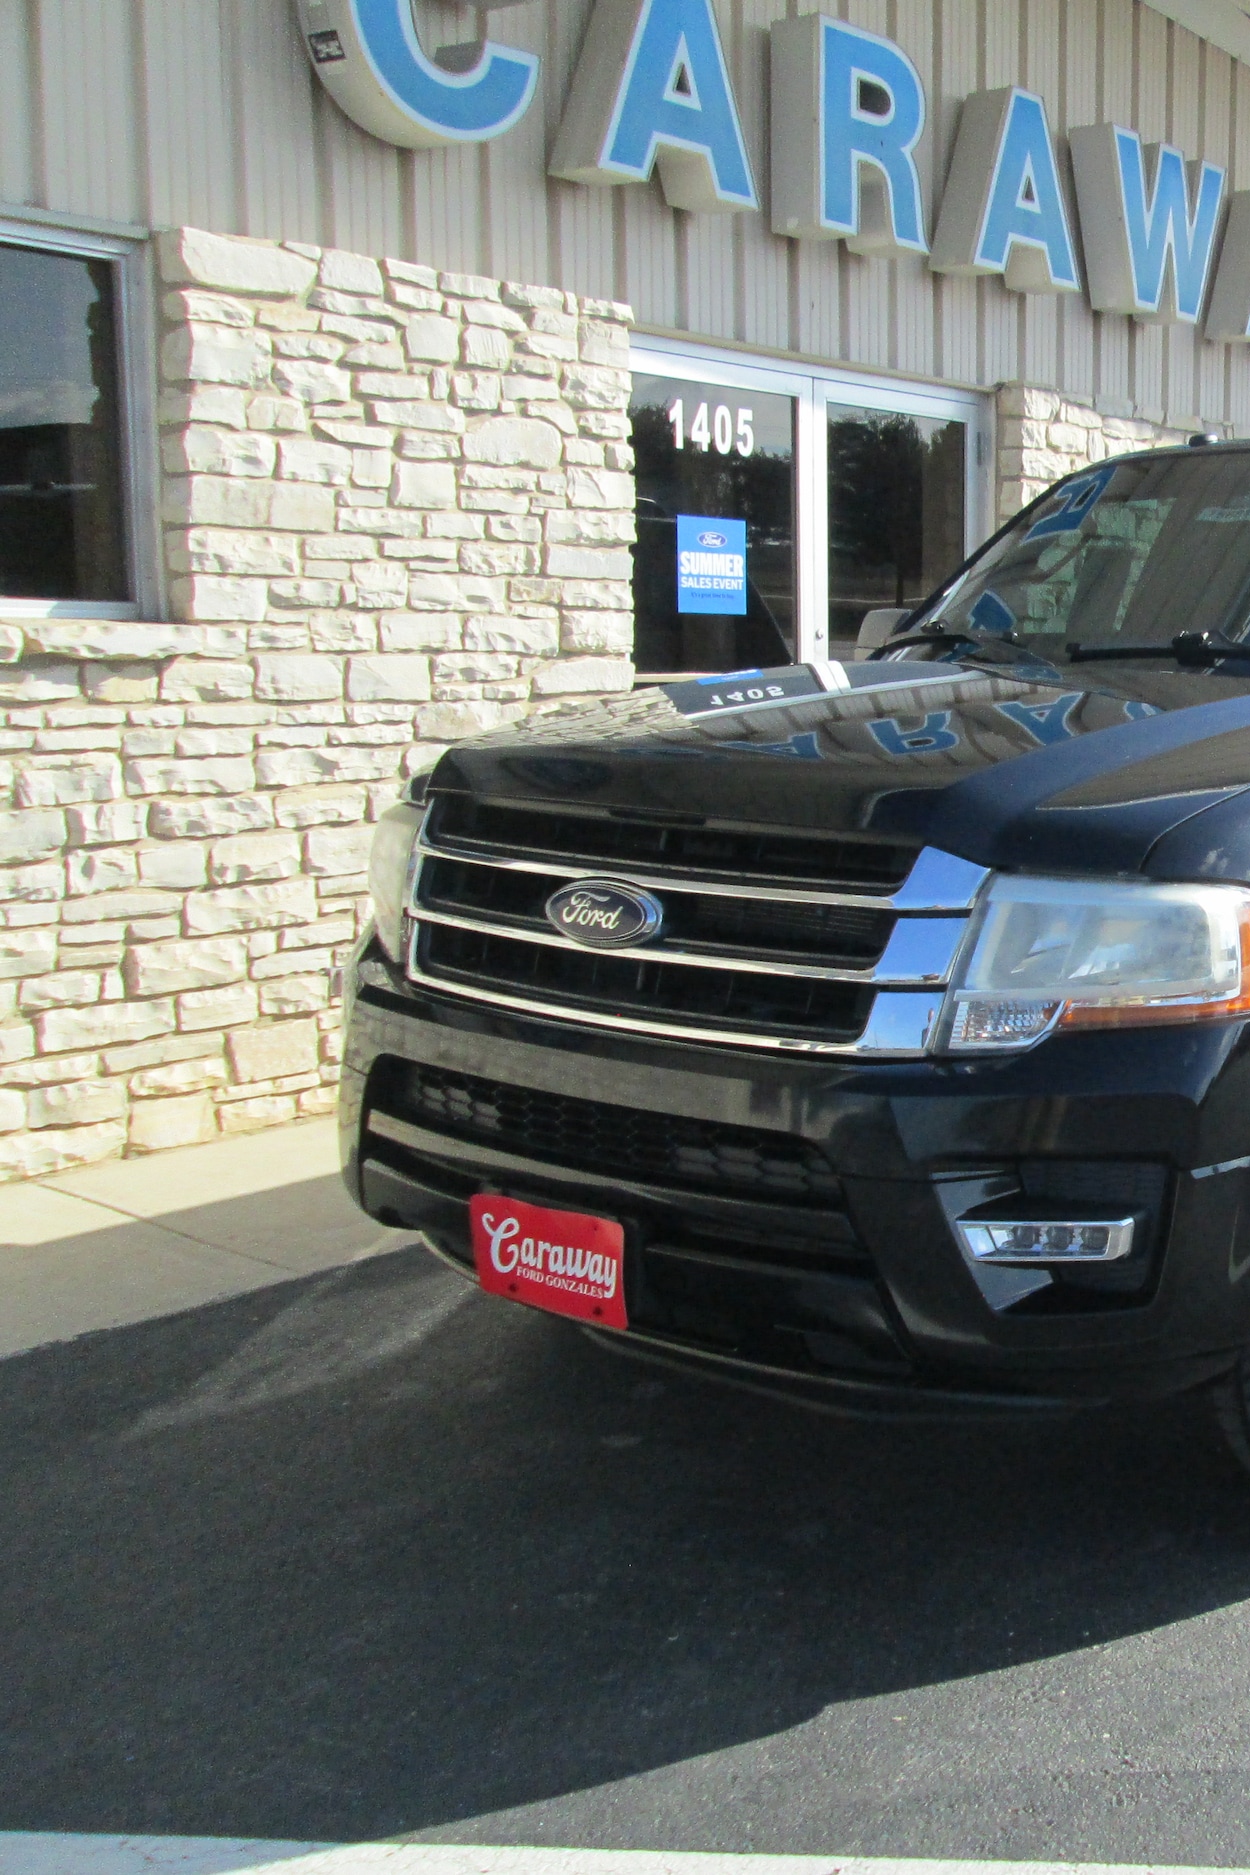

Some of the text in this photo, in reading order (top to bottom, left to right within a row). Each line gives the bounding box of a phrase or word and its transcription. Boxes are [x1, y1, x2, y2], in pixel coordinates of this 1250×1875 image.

[668, 399, 754, 457] 1405
[703, 533, 721, 546] Ford
[680, 551, 744, 577] SUMMER
[681, 576, 744, 591] SALES EVENT
[563, 892, 623, 930] Ford
[482, 1213, 617, 1298] Caraway
[516, 1266, 604, 1299] FORD GONZALES
